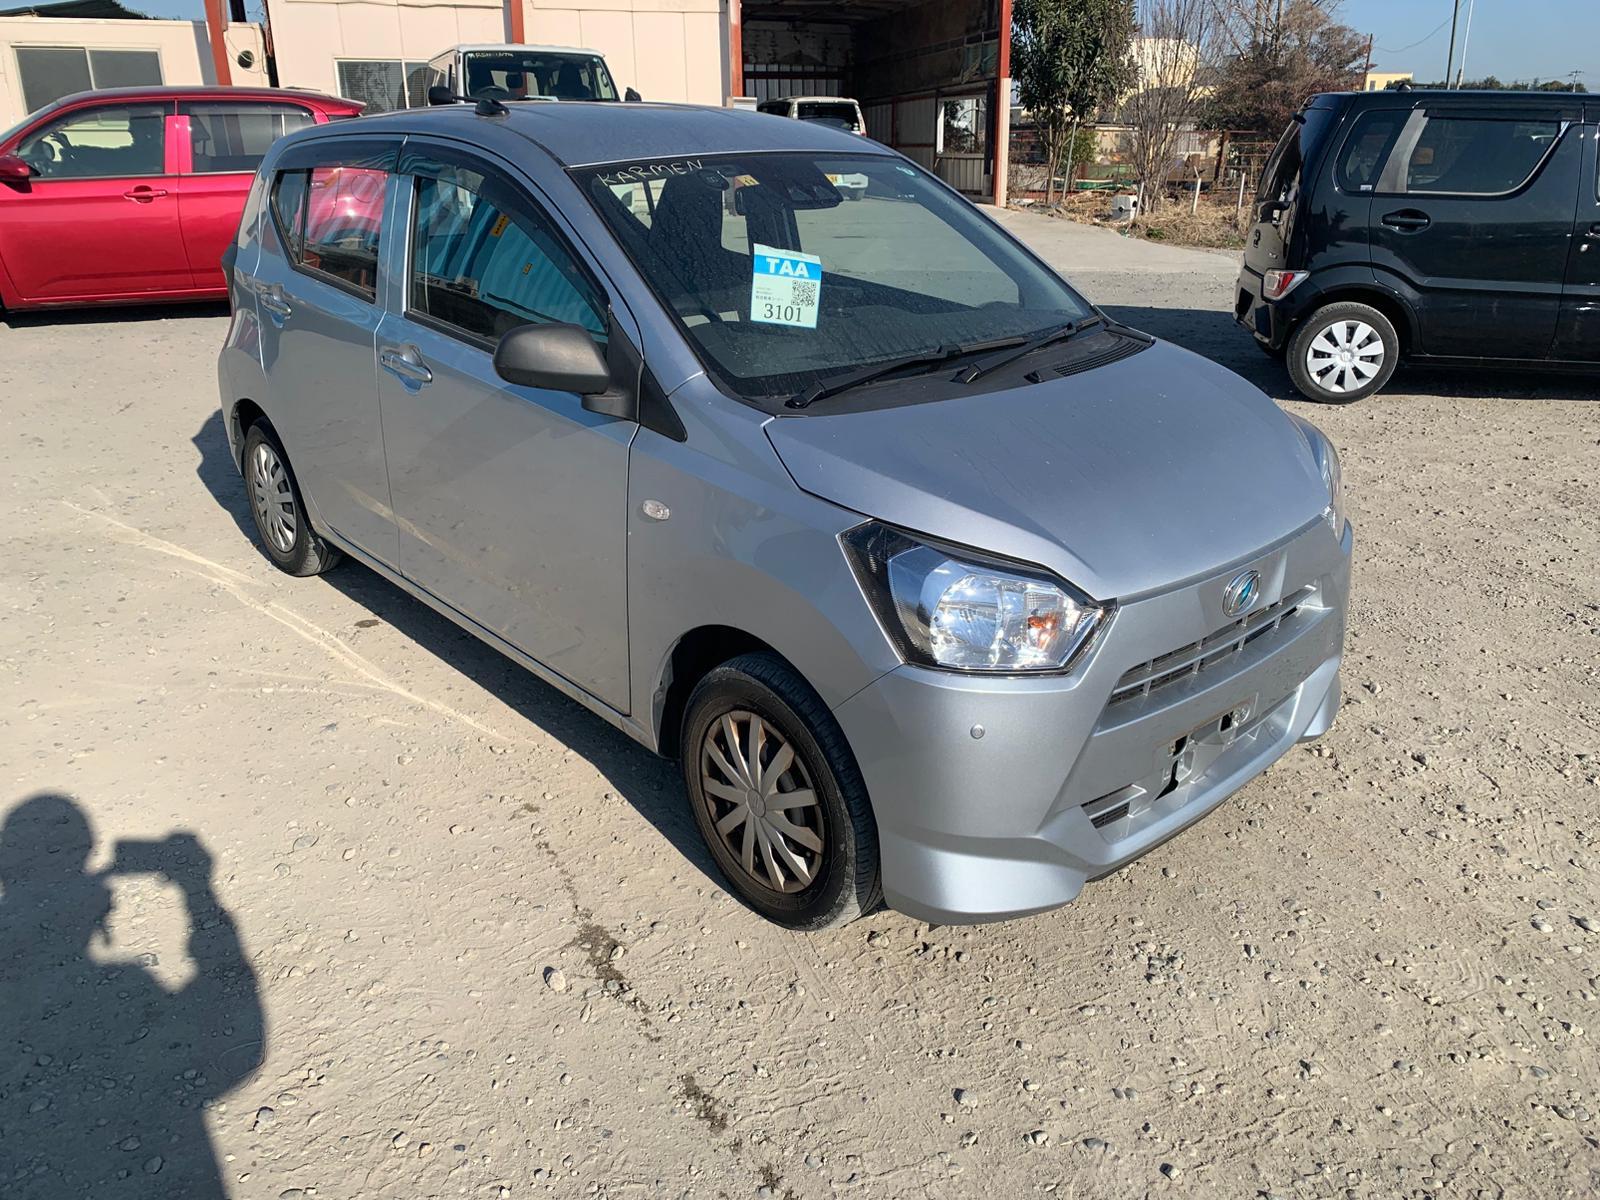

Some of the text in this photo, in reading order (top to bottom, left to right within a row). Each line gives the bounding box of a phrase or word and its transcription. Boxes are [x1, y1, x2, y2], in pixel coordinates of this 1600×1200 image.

[597, 159, 703, 187] KARMEN
[766, 257, 809, 278] TAA
[764, 303, 802, 323] 3101
